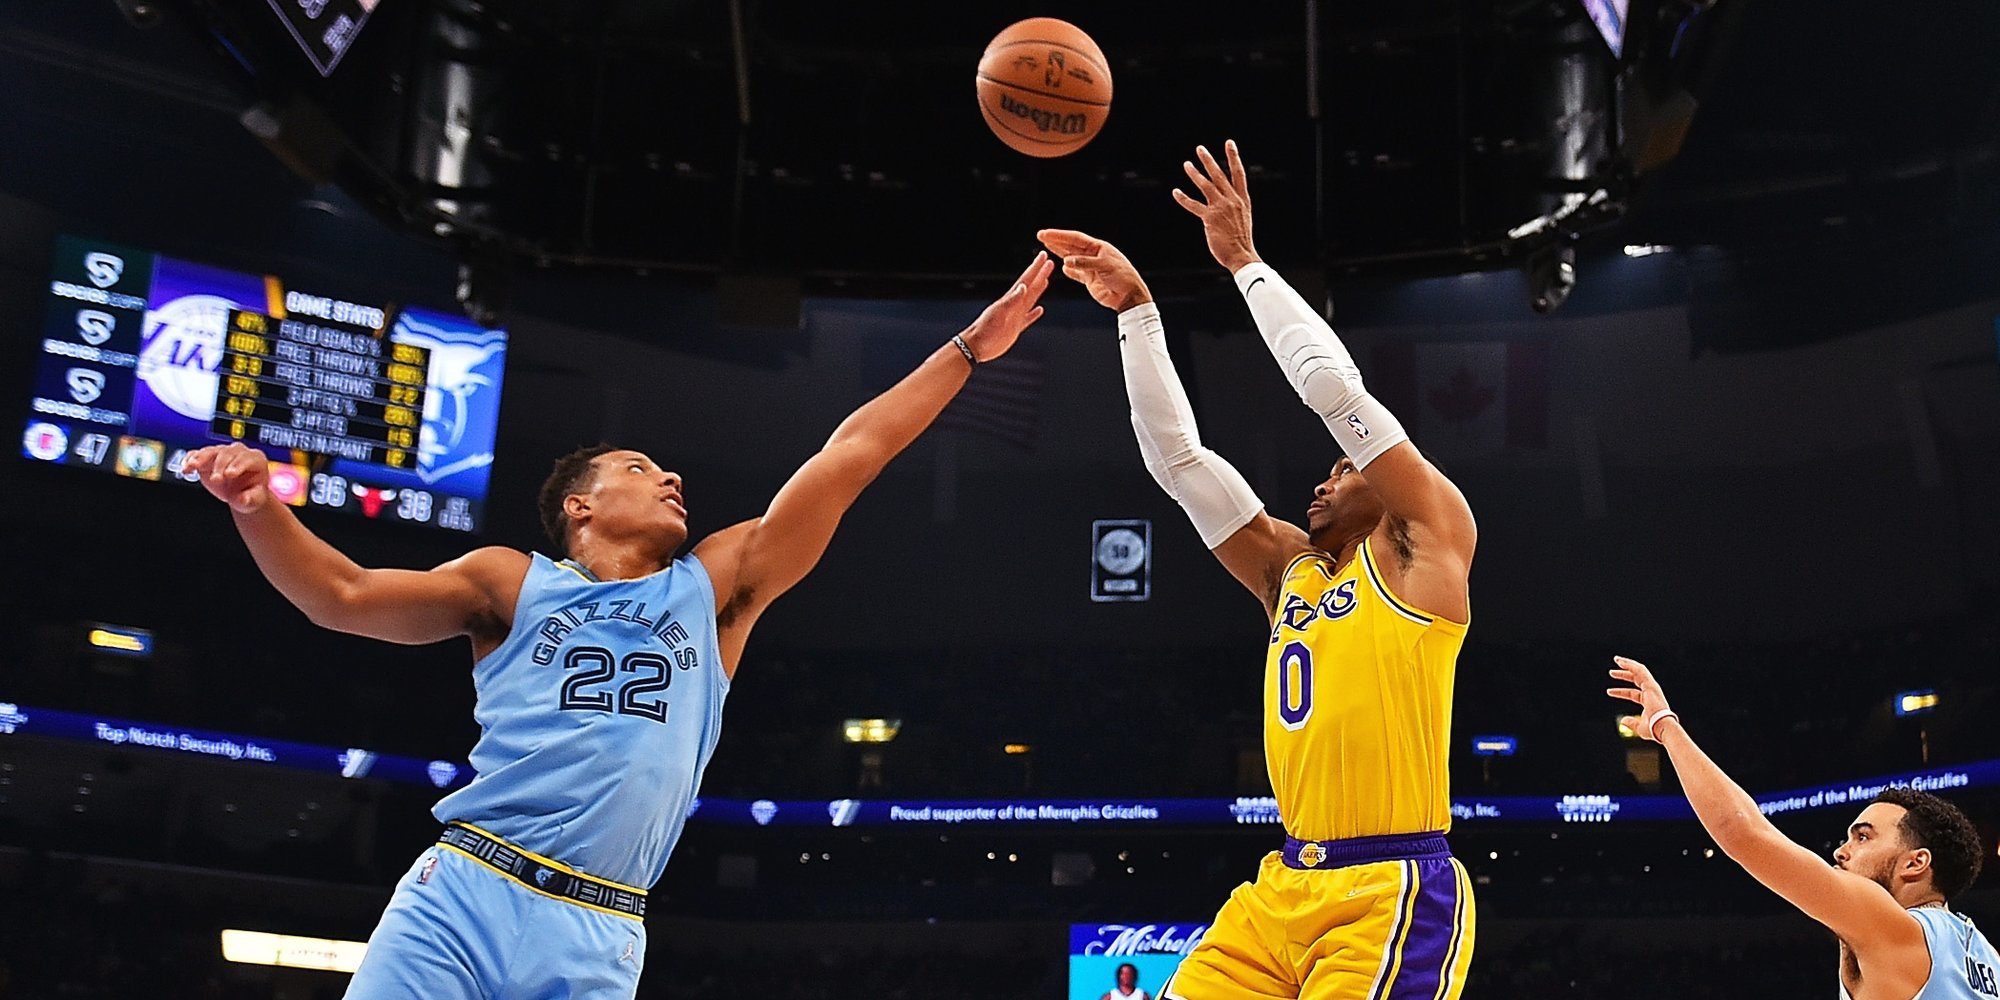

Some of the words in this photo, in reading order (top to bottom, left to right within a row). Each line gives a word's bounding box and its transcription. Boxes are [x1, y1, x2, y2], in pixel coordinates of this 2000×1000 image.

[1001, 92, 1088, 134] Wilson
[286, 290, 334, 320] GAME
[333, 300, 385, 330] STATS
[275, 338, 312, 365] FREE
[313, 348, 366, 376] THROW
[275, 361, 311, 387] FREE
[313, 371, 375, 399] THROWS
[75, 433, 111, 465] 47
[310, 472, 347, 507] 36
[397, 487, 433, 522] 38
[531, 599, 699, 671] GRIZZLIES
[559, 646, 673, 724] 22
[1279, 639, 1314, 733] 0
[95, 722, 130, 744] Top
[129, 727, 181, 749] Notch
[245, 743, 276, 762] Inc.
[890, 806, 931, 820] Proud
[932, 806, 997, 823] supporter
[997, 805, 1014, 820] of
[1014, 806, 1037, 820] the
[1038, 805, 1101, 823] Memphis
[1101, 805, 1159, 820] Grizzlies
[1759, 797, 1807, 816] pporter
[1809, 791, 1824, 807] of
[1825, 788, 1847, 804] the
[1911, 772, 1969, 791] Grizzlies
